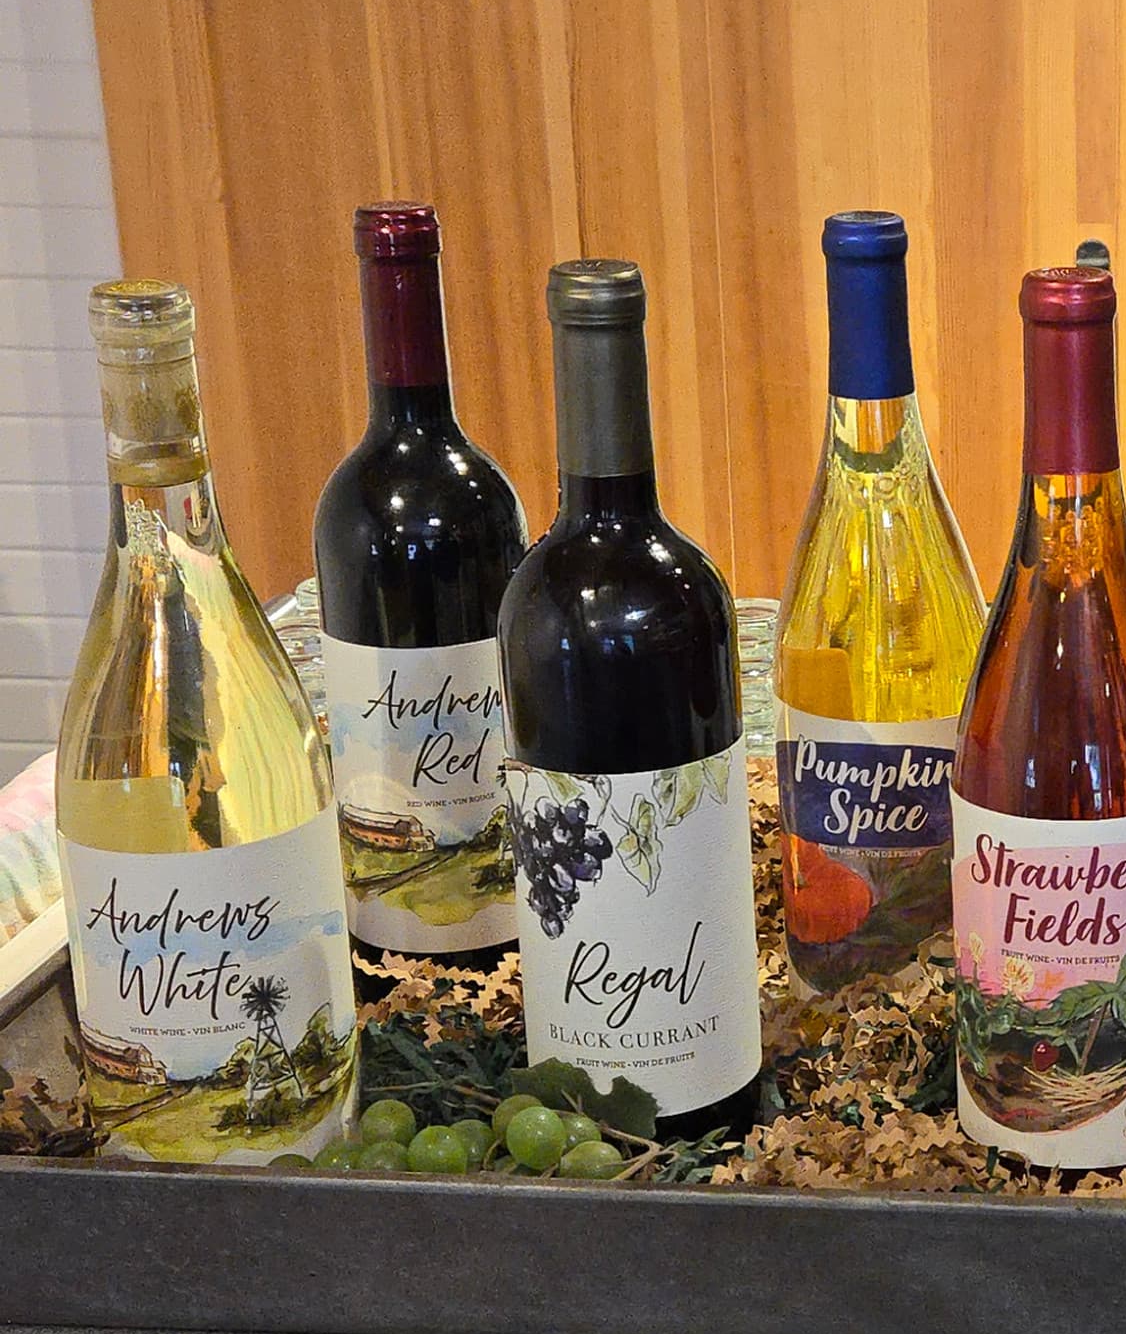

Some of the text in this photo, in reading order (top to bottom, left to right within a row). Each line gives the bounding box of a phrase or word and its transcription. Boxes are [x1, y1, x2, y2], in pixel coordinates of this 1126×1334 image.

[361, 670, 502, 731] Andrew
[412, 728, 490, 788] Red
[406, 800, 422, 808] RED
[423, 800, 447, 808] WINE
[452, 797, 468, 806] VIN
[824, 788, 929, 844] Spice
[86, 877, 281, 950] Andrews
[119, 948, 252, 1020] White
[564, 921, 706, 1029] Regal
[1001, 948, 1121, 965] FRUIT WINE VIN DE FRUITS
[129, 1021, 246, 1037] WHITE WINE VIN BLANC
[549, 1014, 721, 1049] BLACK CURRANT
[576, 1051, 696, 1069] FRUIT WINE VIN DE FRUITS
